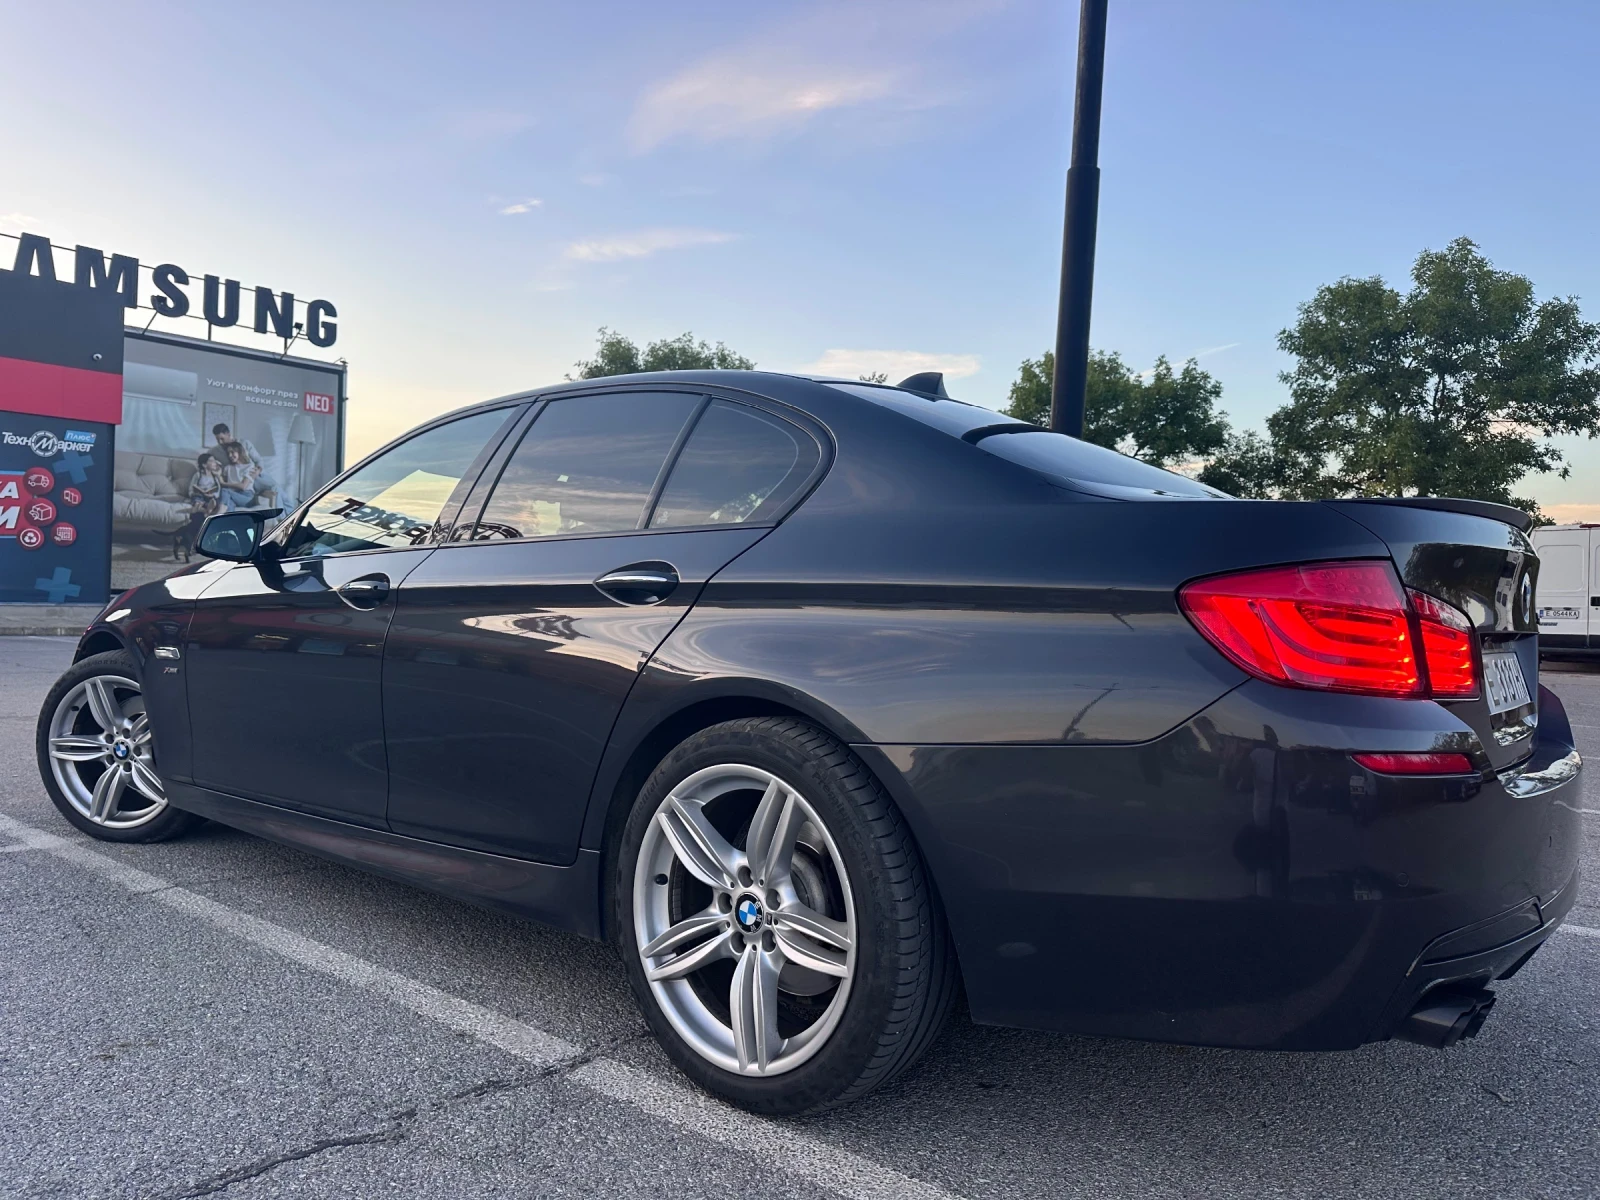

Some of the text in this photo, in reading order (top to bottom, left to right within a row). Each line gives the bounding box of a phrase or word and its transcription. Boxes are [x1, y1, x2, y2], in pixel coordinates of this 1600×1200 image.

[206, 378, 225, 389] Уют
[235, 383, 276, 396] комфорт
[277, 391, 298, 399] през
[245, 395, 298, 408] всеки сезон
[305, 394, 330, 412] NEO
